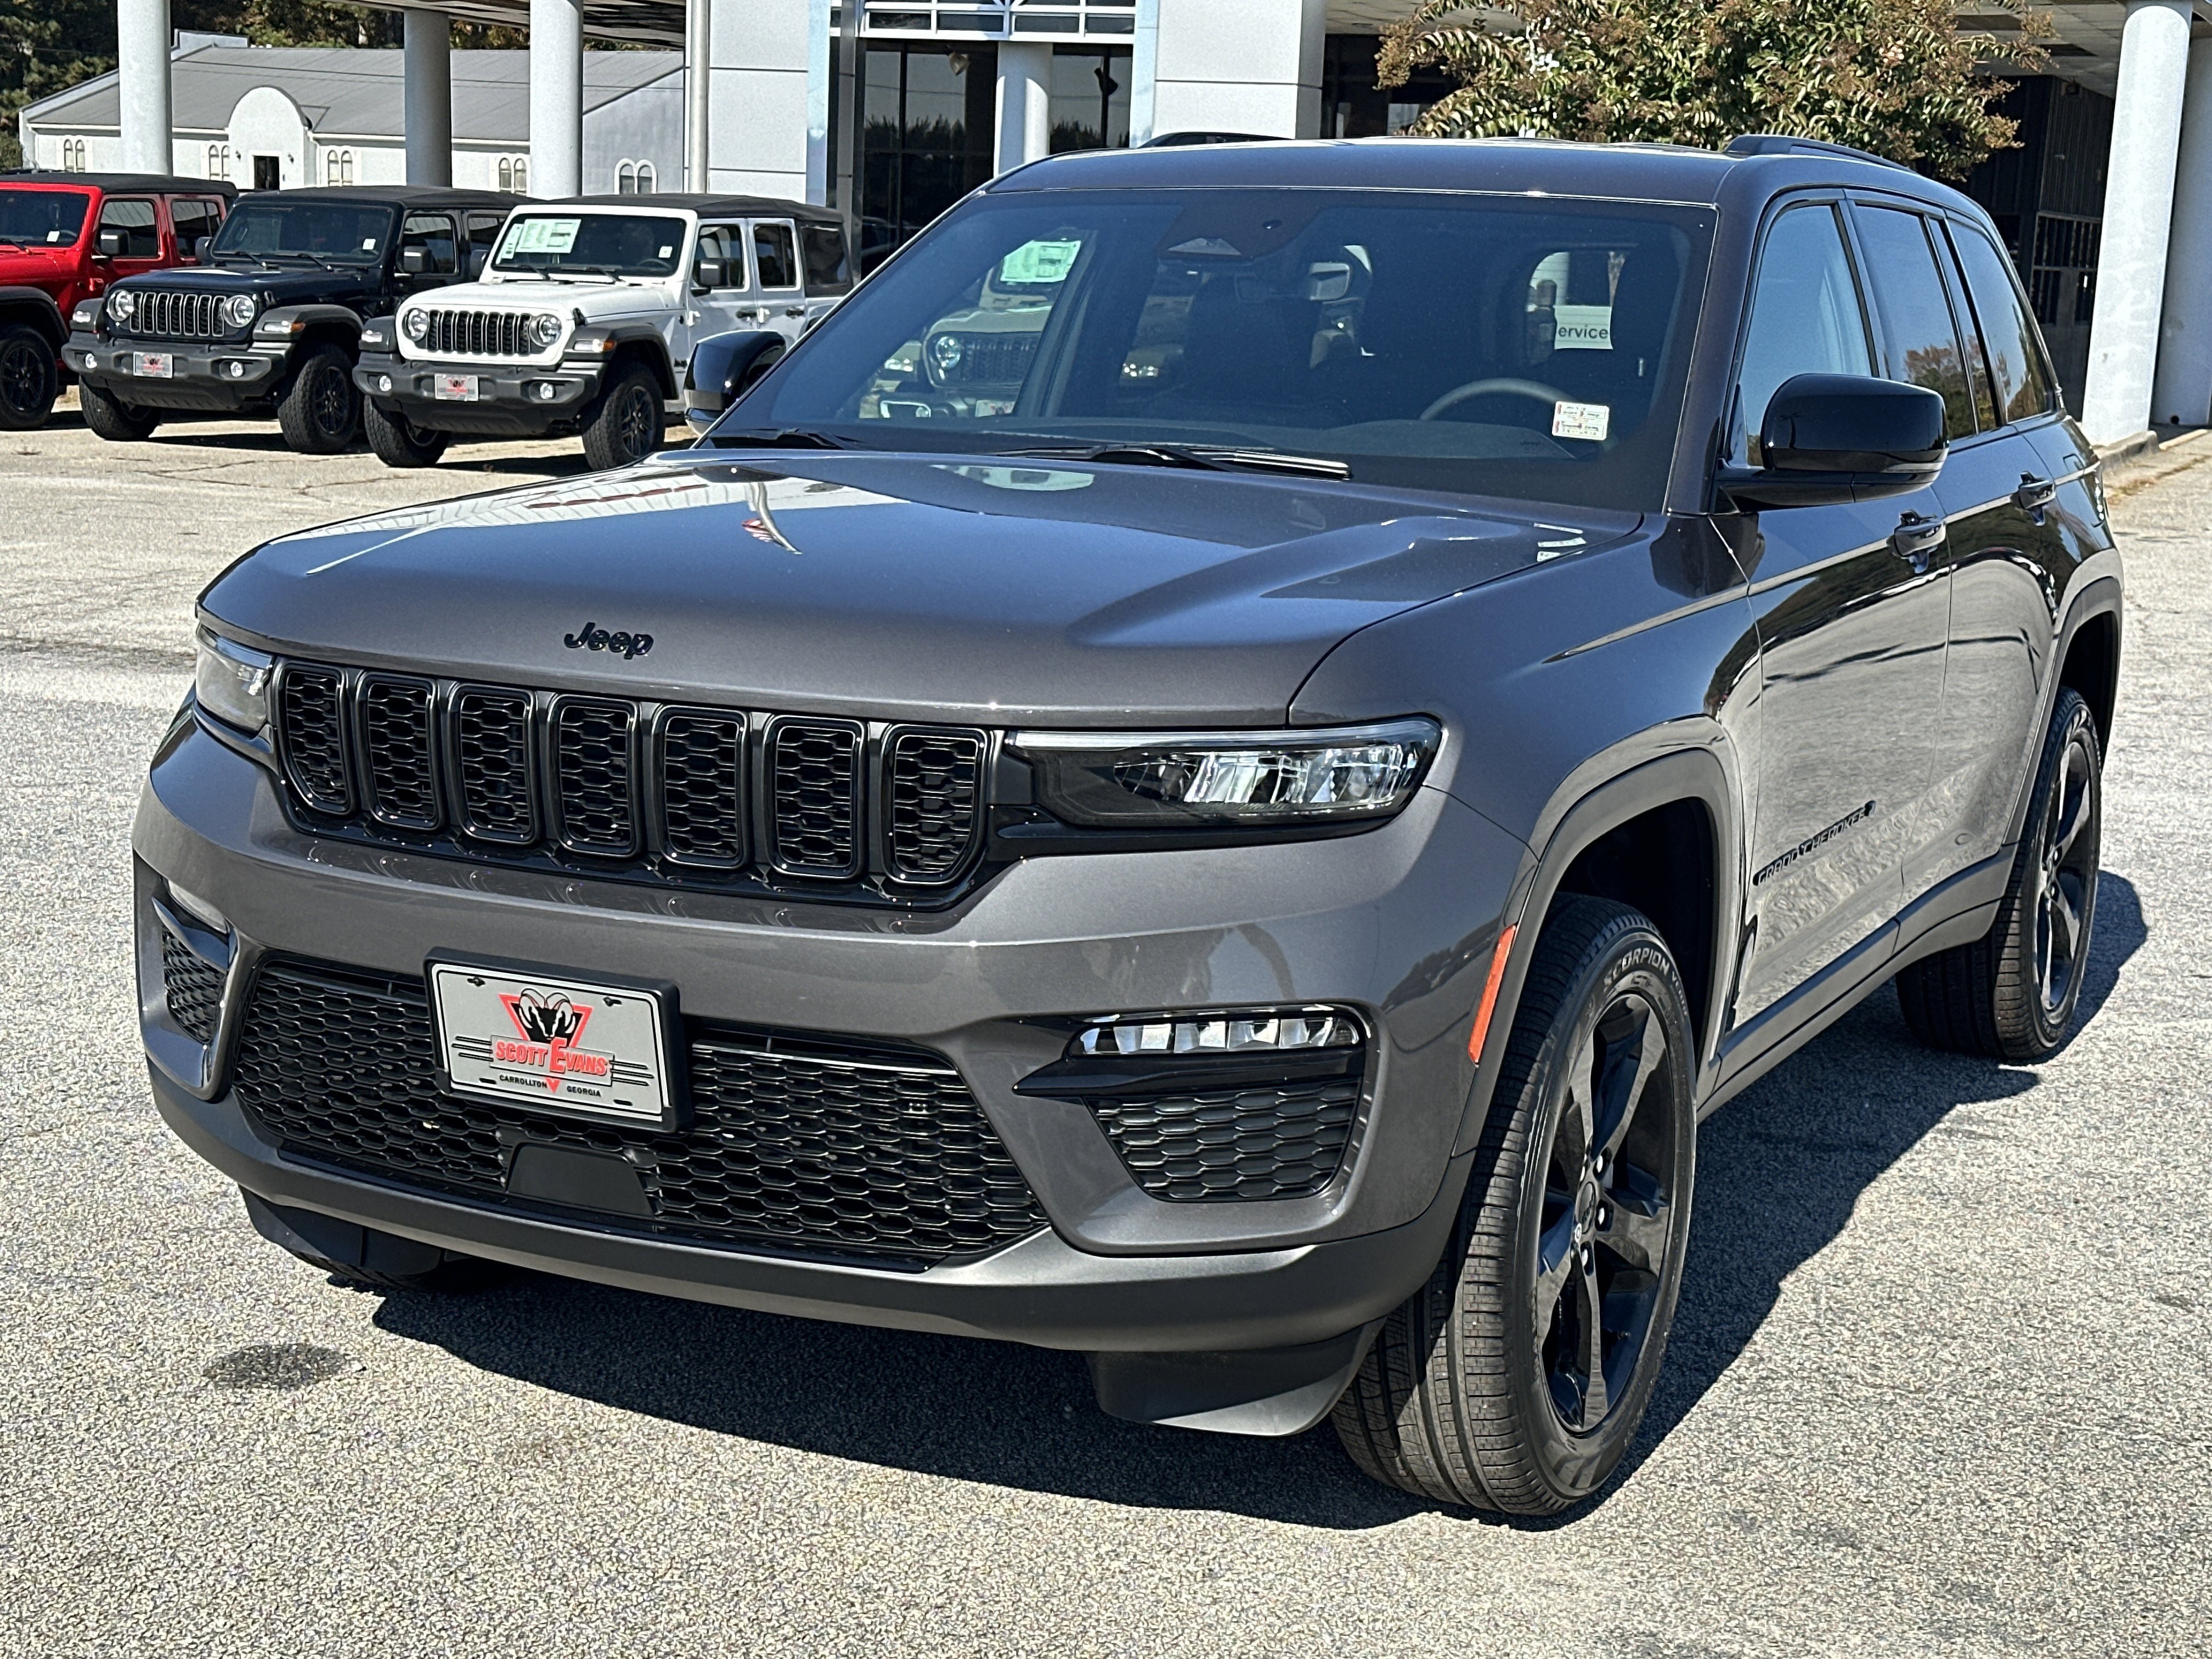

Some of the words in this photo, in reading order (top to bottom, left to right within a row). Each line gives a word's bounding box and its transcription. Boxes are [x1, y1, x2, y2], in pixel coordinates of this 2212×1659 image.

[564, 622, 654, 660] Jeep
[1752, 848, 1798, 887] GRAND
[1798, 800, 1876, 855] CHEROKEE
[1604, 947, 1669, 992] SCORPION
[495, 1041, 548, 1066] SCOTT
[550, 1037, 607, 1075] EVANS
[499, 1074, 548, 1088] CARROLLTON
[567, 1086, 601, 1097] GEORGIA
